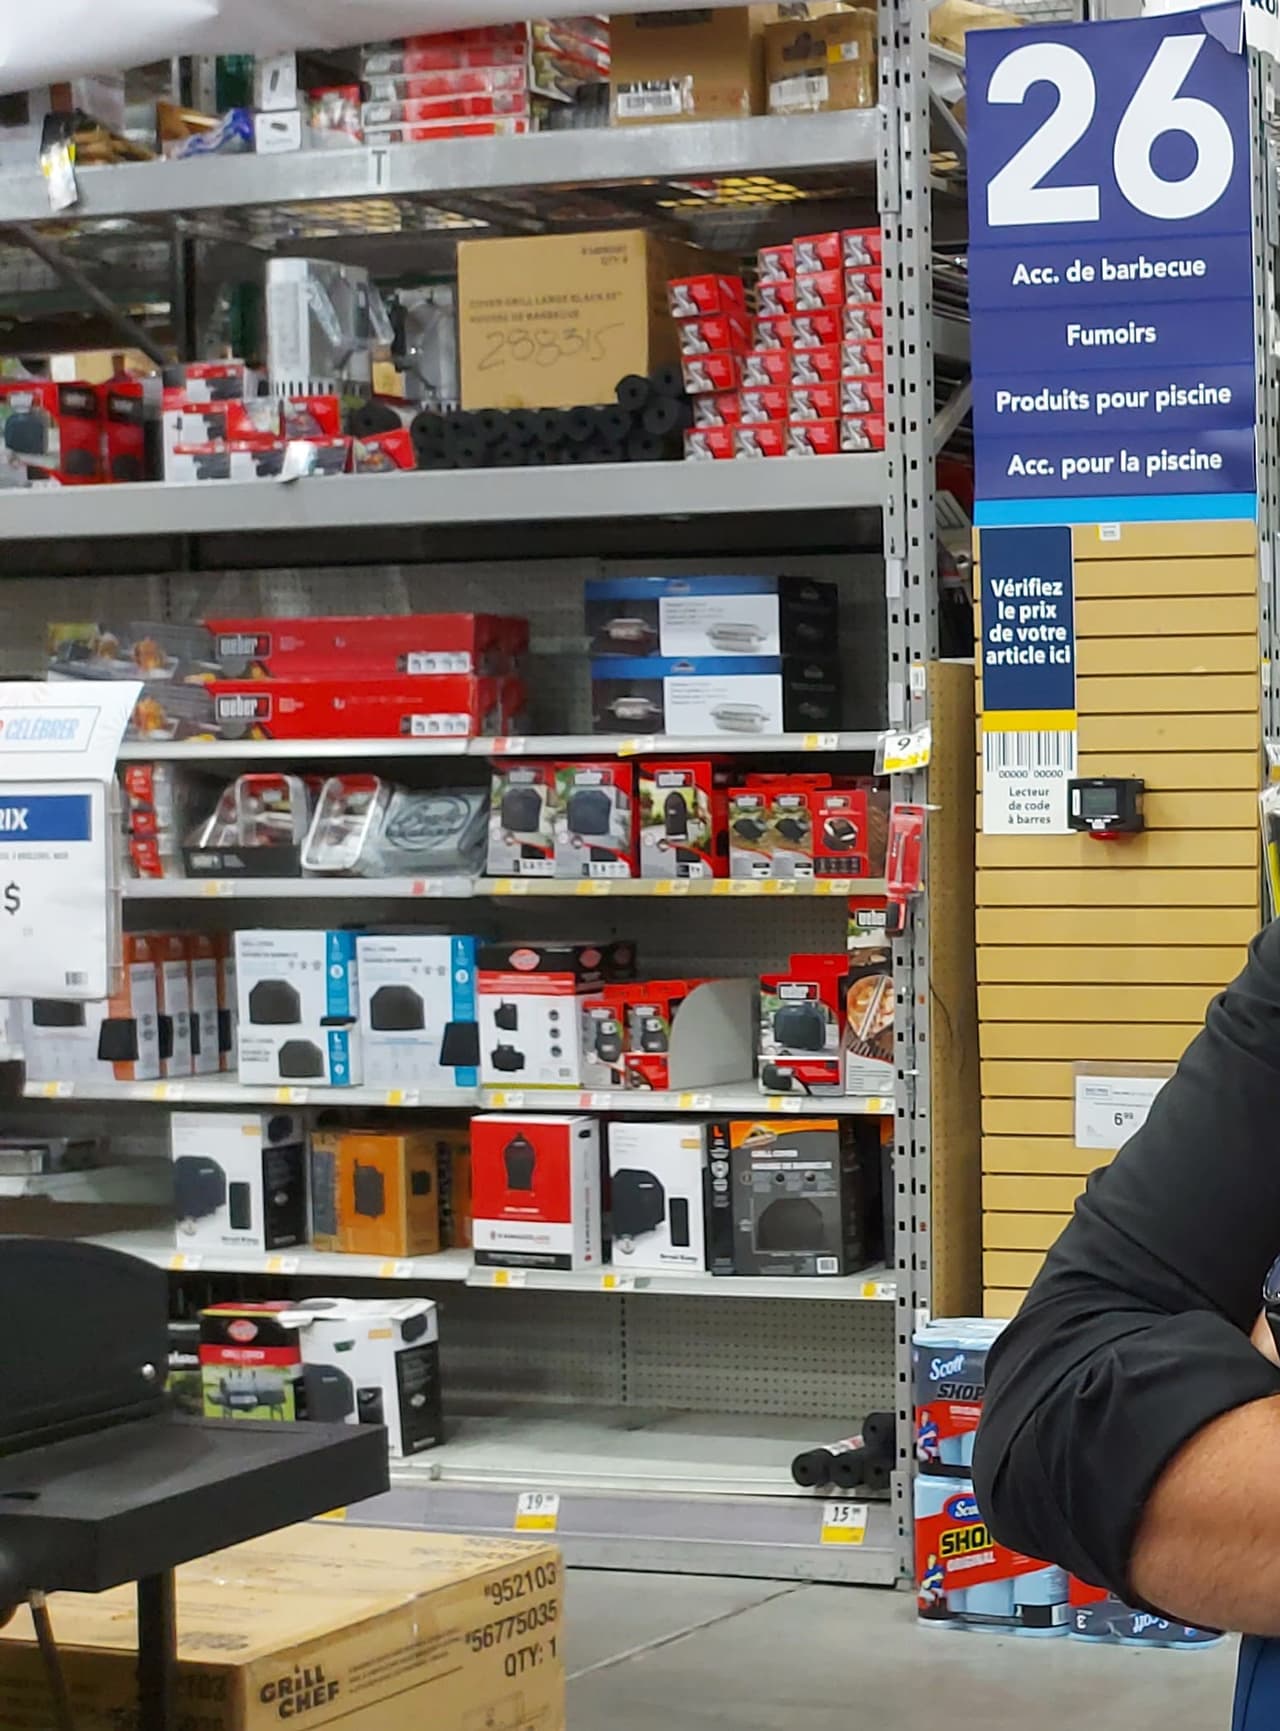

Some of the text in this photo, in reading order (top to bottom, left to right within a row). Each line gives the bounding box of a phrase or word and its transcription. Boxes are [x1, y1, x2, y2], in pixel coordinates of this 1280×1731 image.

[987, 33, 1235, 227] 26
[1012, 256, 1207, 285] Acc. de barbecue
[1067, 321, 1157, 347] Fumoirs
[996, 383, 1232, 415] Produits pour piscine
[1008, 449, 1223, 480] Acc. pour la piscine
[990, 577, 1063, 598] Vérifiez
[998, 600, 1056, 624] le prix
[989, 624, 1067, 642] de votre
[986, 645, 1072, 665] article ici
[1008, 799, 1051, 811] de code
[1009, 786, 1050, 798] Lecteur
[1016, 813, 1051, 825] barres
[929, 1354, 965, 1381] Scott
[937, 1382, 985, 1401] SHOP
[954, 1500, 980, 1518] Sco
[484, 1562, 557, 1606] #952103
[465, 1601, 558, 1653] #56775035
[504, 1651, 544, 1679] QTY:
[278, 1682, 340, 1720] CHEF
